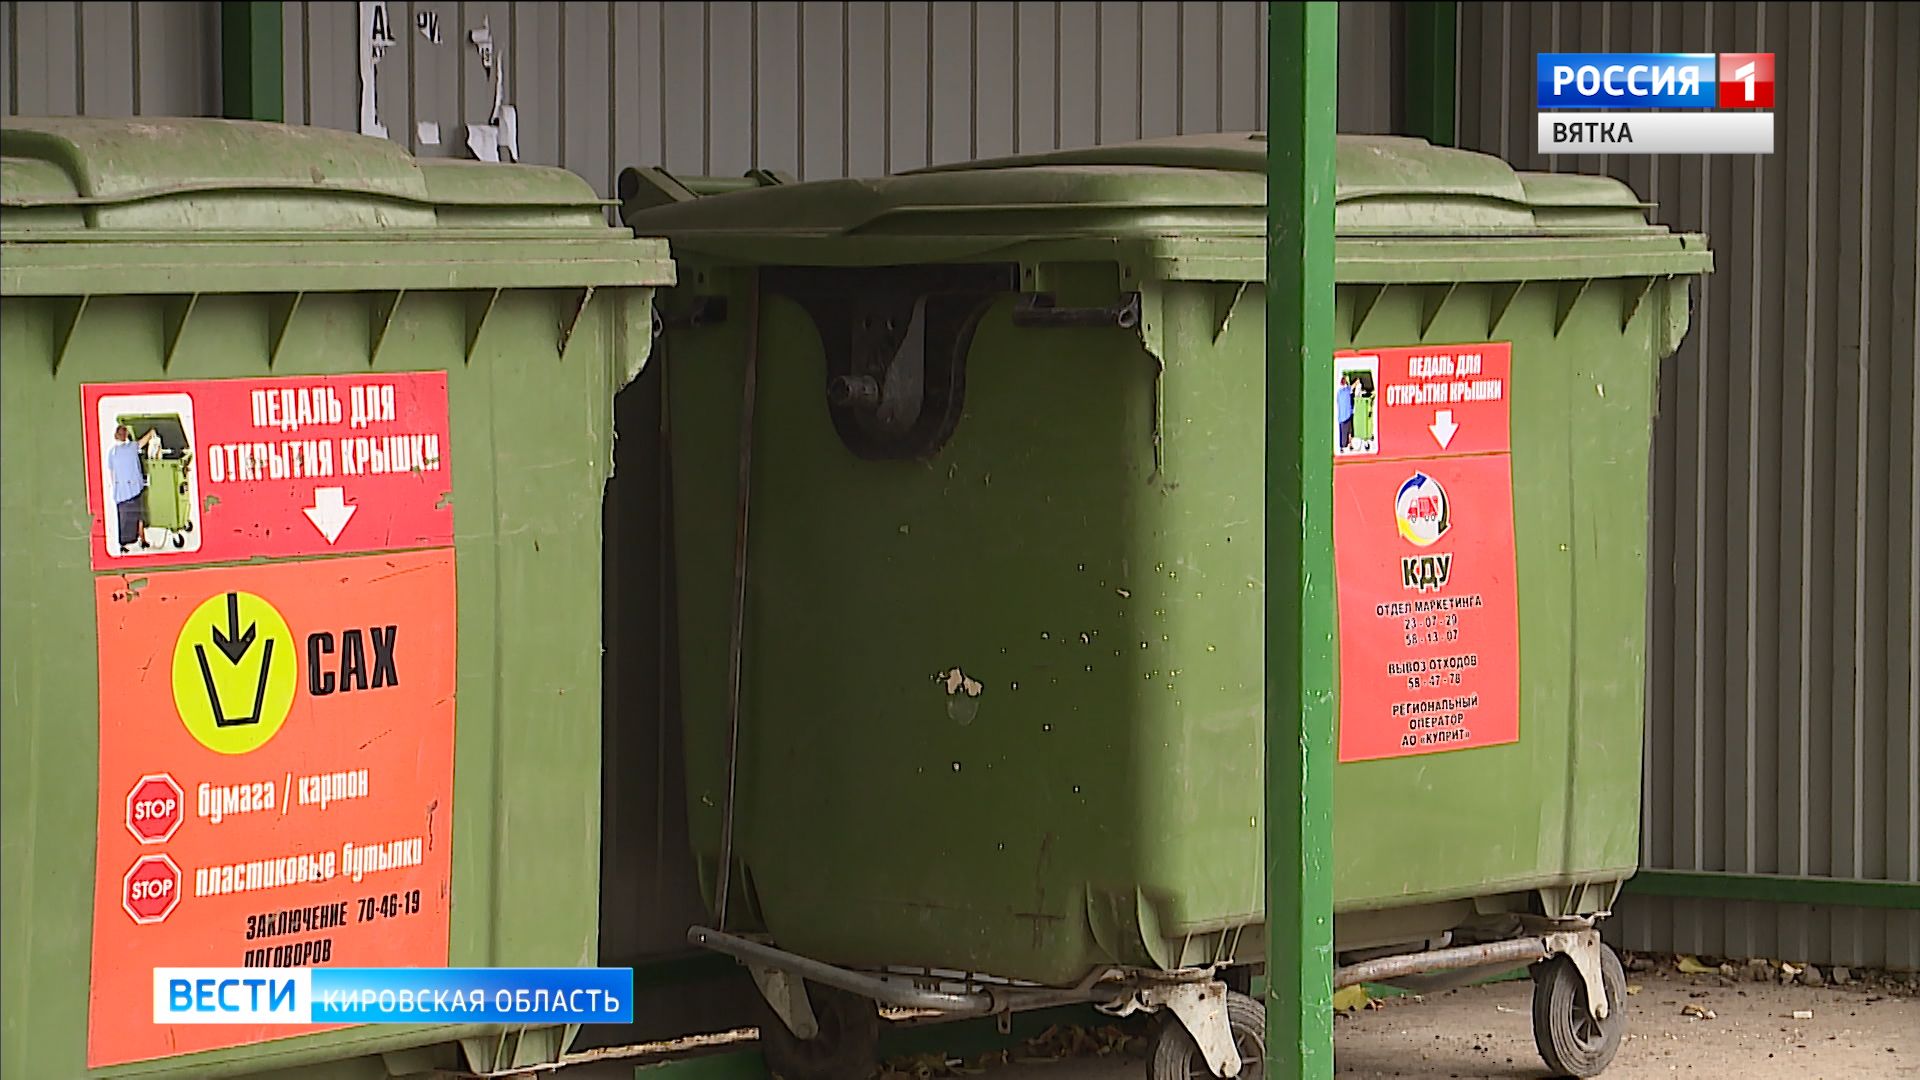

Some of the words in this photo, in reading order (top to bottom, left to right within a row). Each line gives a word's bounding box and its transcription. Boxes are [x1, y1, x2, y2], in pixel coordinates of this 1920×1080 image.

[1408, 356, 1454, 380] ПЕДАЛЬ
[1456, 354, 1482, 378] ДЛЯ
[1386, 382, 1449, 406] ОТКРЫТИЯ
[1451, 379, 1502, 403] КРЫШКИ
[252, 386, 342, 431] ПЕДАЛЬ
[350, 384, 396, 429] ДЛЯ
[209, 438, 334, 483] ОТКРЫТИЯ
[341, 434, 440, 475] КРЫШКИ
[1402, 554, 1451, 591] КДУ
[1376, 603, 1412, 616] ОТДЕЛ
[1414, 595, 1482, 612] МАРКЕТИНГА
[307, 625, 399, 697] САХ
[1388, 661, 1427, 675] ВЫВОЗ
[1429, 655, 1477, 670] ОТХОДОВ
[1392, 694, 1478, 716] РЕГИОНАЛЬНЫЙ
[1409, 713, 1464, 730] ОПЕРАТОР
[1401, 735, 1417, 746] АО
[197, 781, 275, 824] бумага
[298, 768, 369, 810] картон
[134, 799, 176, 821] STOP
[194, 850, 336, 897] пластиковые
[342, 837, 423, 884] бутылки
[131, 878, 173, 901] STOP
[245, 900, 348, 941] ЗАКЛЮЧЕНИЕ
